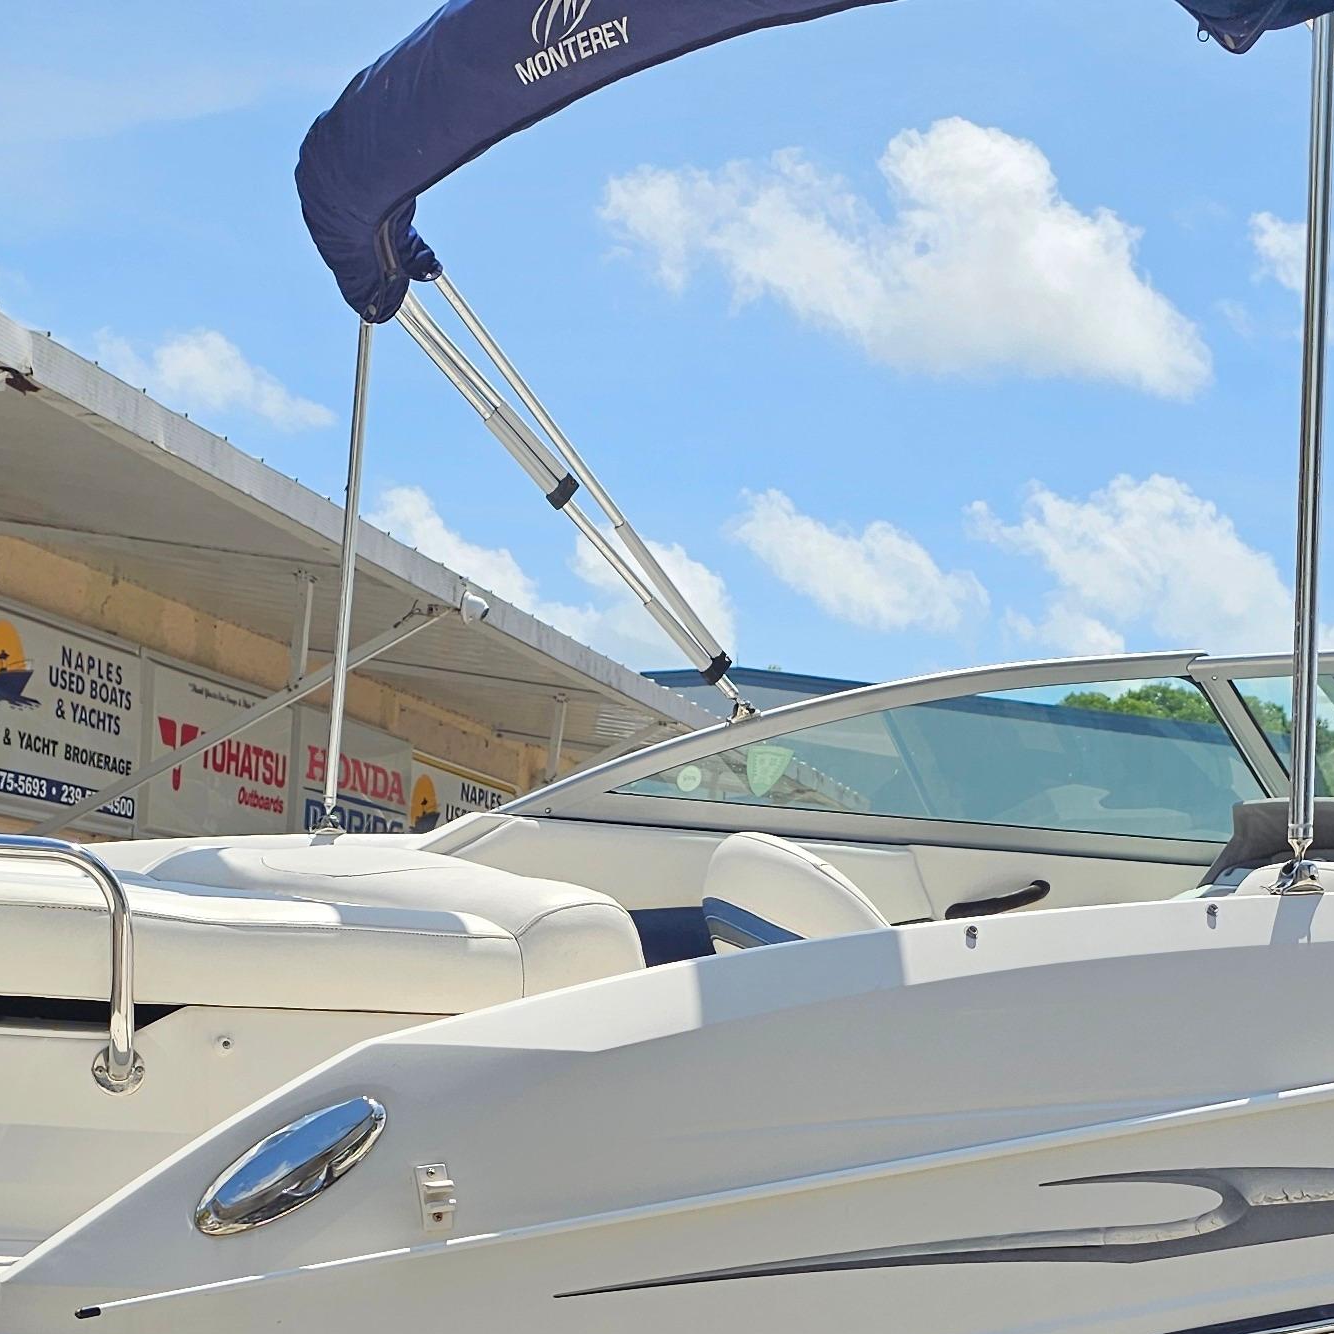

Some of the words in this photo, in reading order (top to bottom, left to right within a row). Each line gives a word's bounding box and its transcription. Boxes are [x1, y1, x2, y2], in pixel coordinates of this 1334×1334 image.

[514, 16, 629, 86] MONTEREY
[61, 645, 123, 686] NAPLES
[49, 665, 85, 695] USED
[90, 679, 132, 711] BOATS
[56, 698, 66, 720] &
[71, 701, 121, 736] YACHTS
[3, 728, 12, 746] &
[18, 731, 59, 758] YACHT
[64, 744, 132, 776] BROKERAGE
[305, 745, 407, 806] HONDA
[460, 782, 502, 810] NAPLES
[238, 786, 284, 814] Outboards
